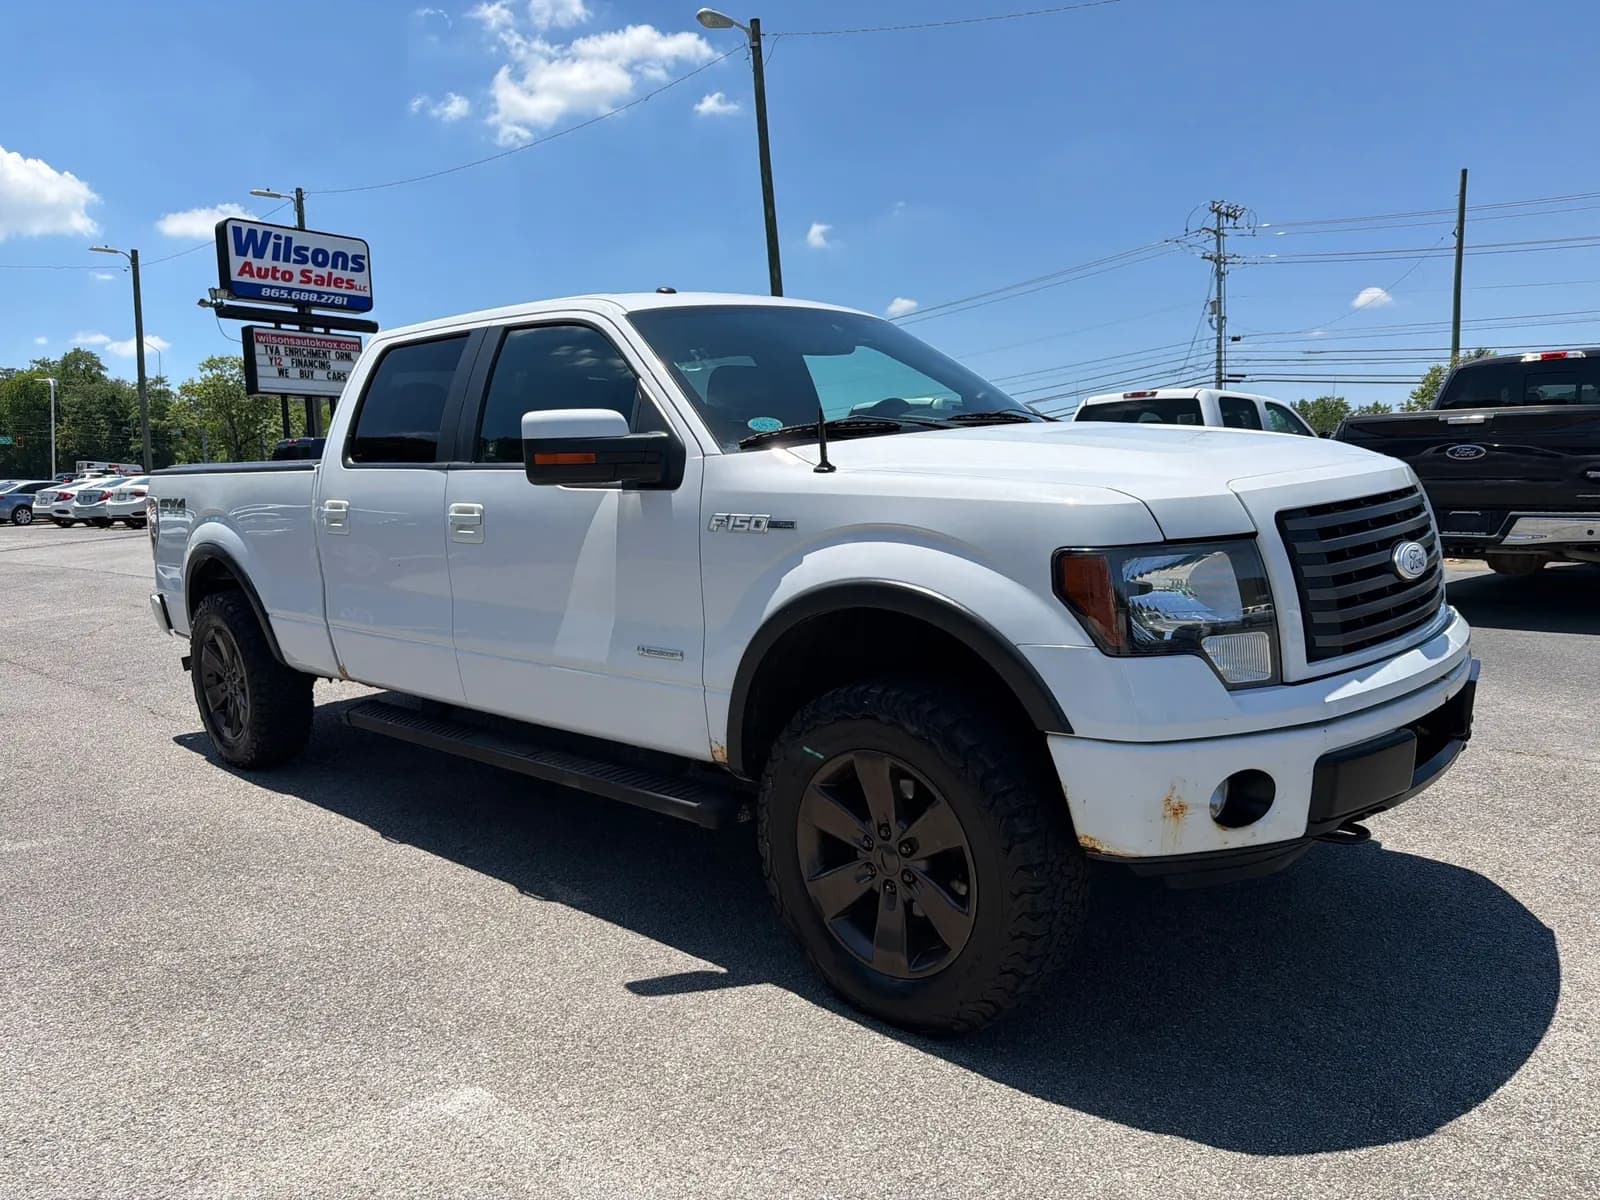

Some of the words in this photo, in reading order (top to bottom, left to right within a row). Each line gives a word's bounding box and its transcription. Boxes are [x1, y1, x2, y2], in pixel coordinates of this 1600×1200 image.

[232, 225, 366, 273] Wilsons
[237, 261, 294, 282] Auto
[299, 268, 356, 291] Sales
[354, 284, 369, 293] LLC
[261, 287, 348, 305] 865.688.2781
[257, 334, 359, 351] wilsonsautoknox.com
[264, 344, 281, 355] TVA
[284, 346, 332, 360] ENRICHMENT
[334, 351, 354, 361] ORNL
[268, 355, 284, 367] Y12
[291, 357, 332, 370] FINANCING
[277, 367, 290, 378] WE
[299, 369, 315, 380] BUY
[326, 371, 348, 382] CARS
